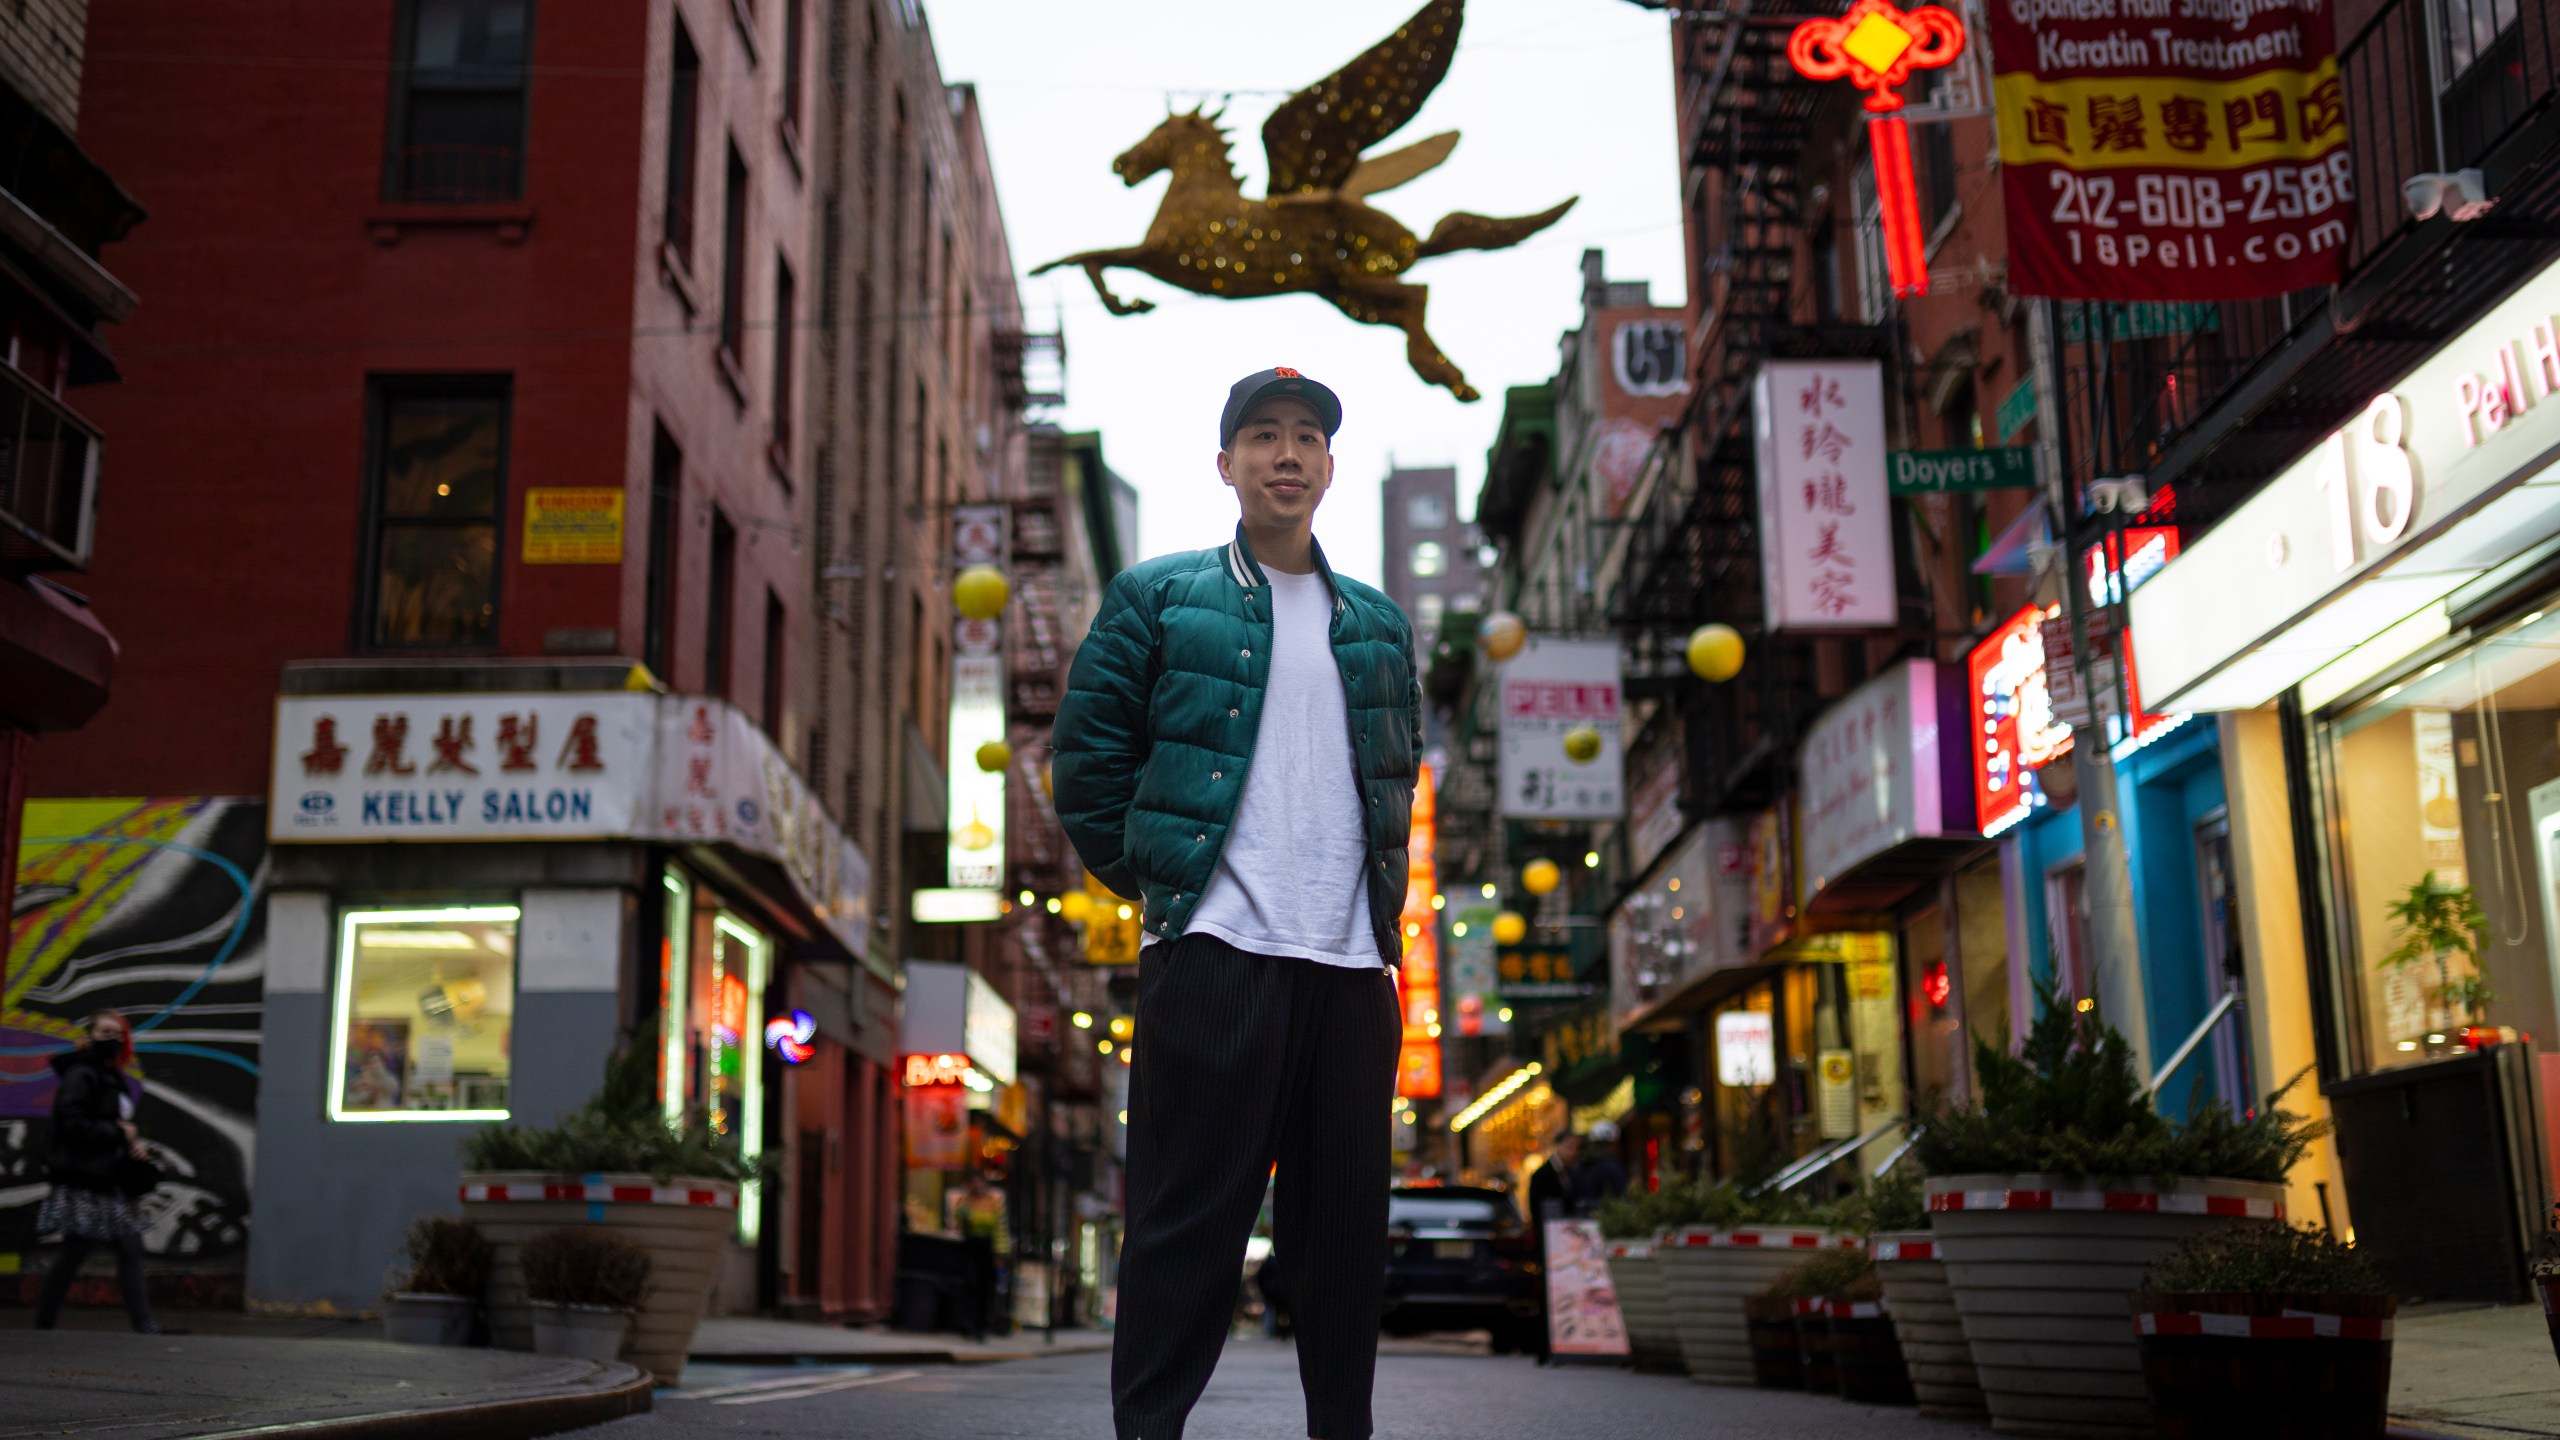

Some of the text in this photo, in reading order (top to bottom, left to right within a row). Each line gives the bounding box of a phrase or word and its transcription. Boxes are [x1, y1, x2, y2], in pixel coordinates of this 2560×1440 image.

[2036, 22, 2302, 72] Keratin Treatment
[2050, 150, 2354, 228] 212-608-2588
[1896, 453, 1996, 492] Doyers
[2315, 315, 2560, 574] 18 Pell H
[301, 711, 605, 779] 嘉麗髮型屋
[362, 789, 465, 827] KELLY
[482, 788, 592, 824] SALON
